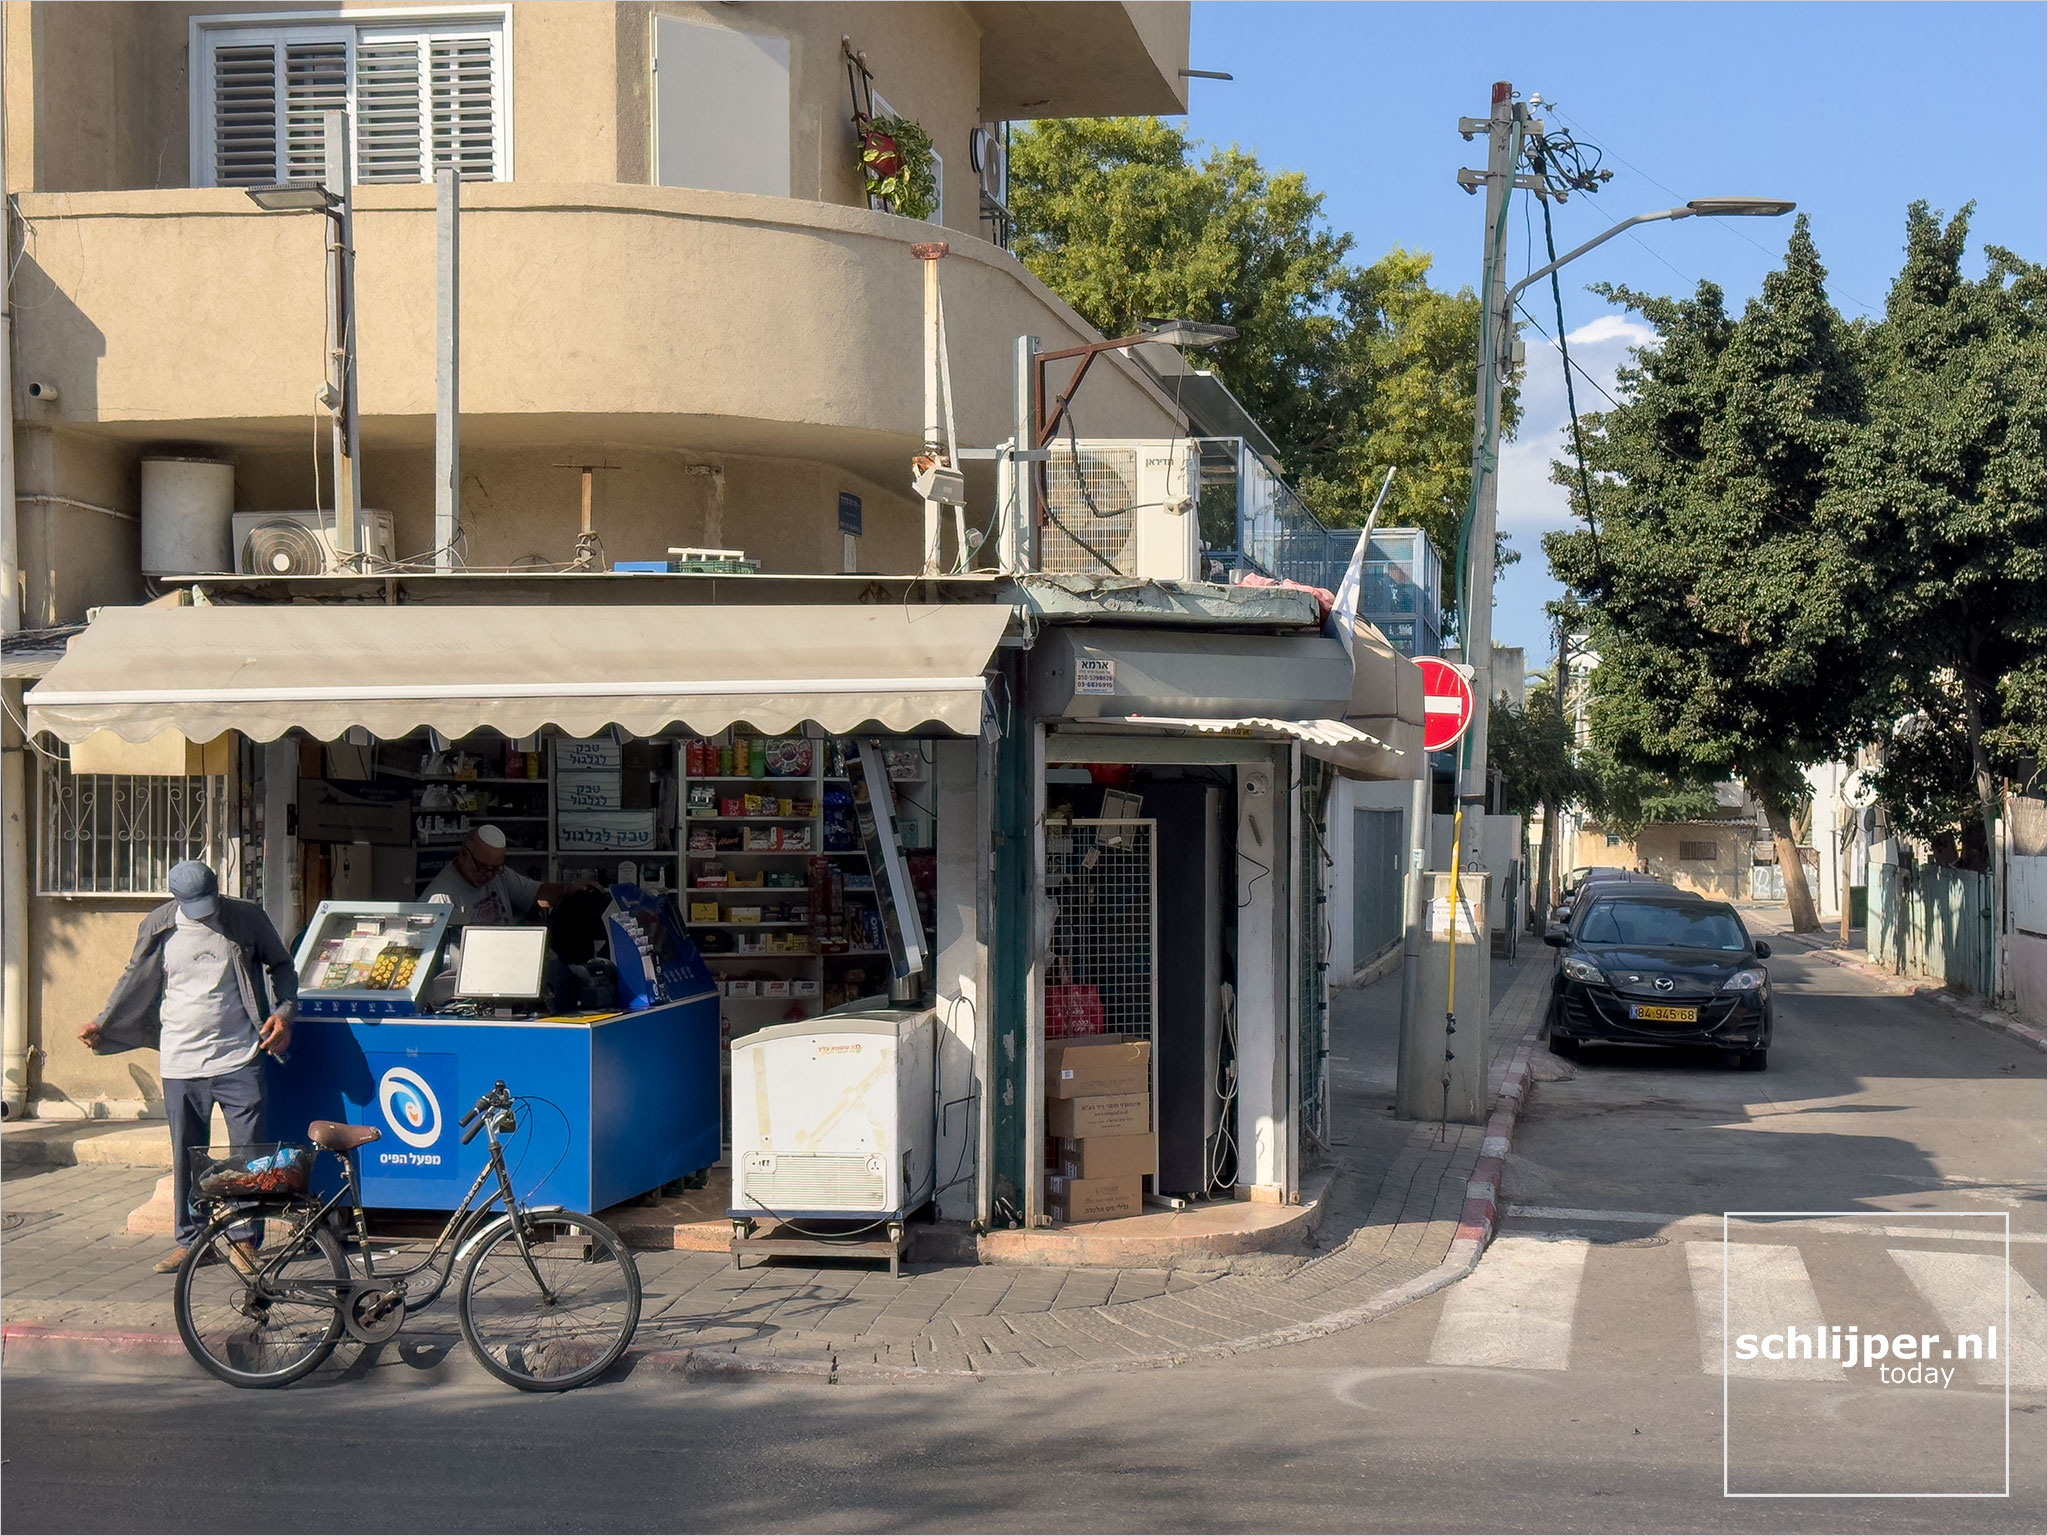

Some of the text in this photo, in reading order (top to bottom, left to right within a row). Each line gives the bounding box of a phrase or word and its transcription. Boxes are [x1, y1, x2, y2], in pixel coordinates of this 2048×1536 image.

[1081, 660, 1109, 669] ארמא
[576, 744, 600, 754] טבק
[570, 754, 607, 765] לגלגול
[576, 785, 600, 795] טבק
[570, 795, 607, 806] לגלגול
[563, 828, 649, 845] טבק לגלגול
[380, 1153, 441, 1165] מפעל הפיס
